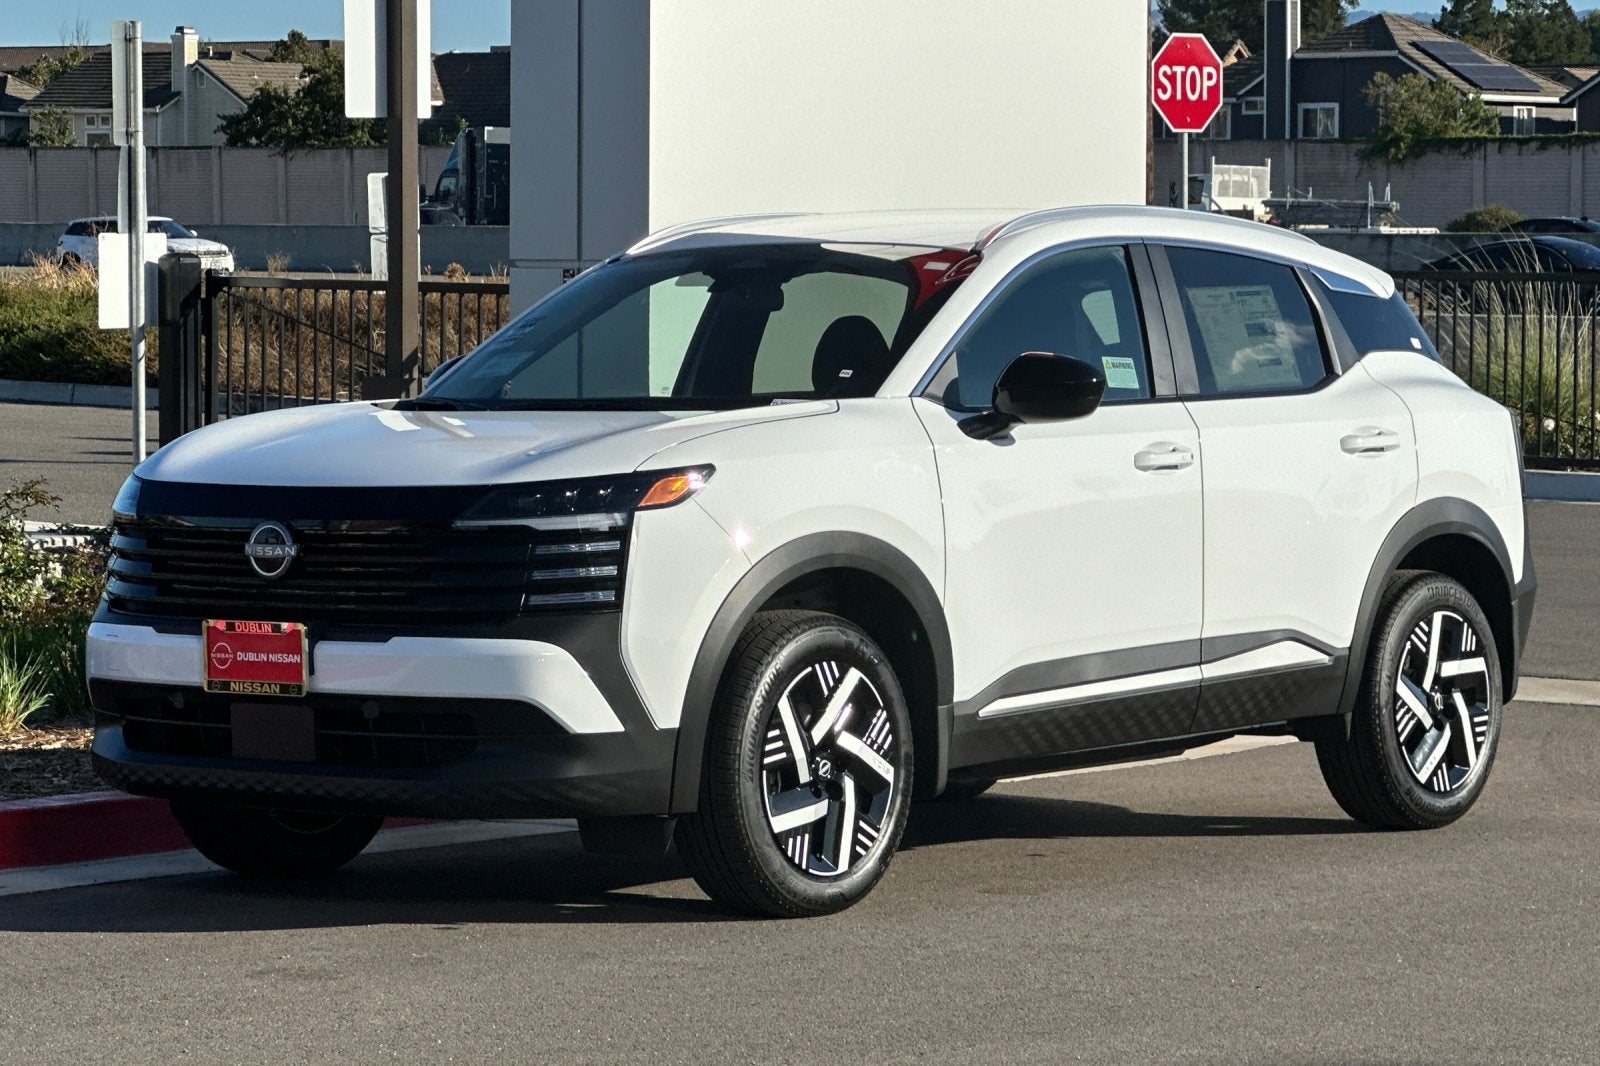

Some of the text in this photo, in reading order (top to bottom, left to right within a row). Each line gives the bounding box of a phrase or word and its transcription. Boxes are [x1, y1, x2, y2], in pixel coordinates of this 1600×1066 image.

[1157, 65, 1217, 101] STOP
[1111, 361, 1134, 369] WARNING
[246, 544, 296, 557] NISSAN
[235, 622, 272, 633] DUBLIN
[237, 652, 301, 664] DUBLIN NISSAN
[230, 681, 280, 694] NISSAN
